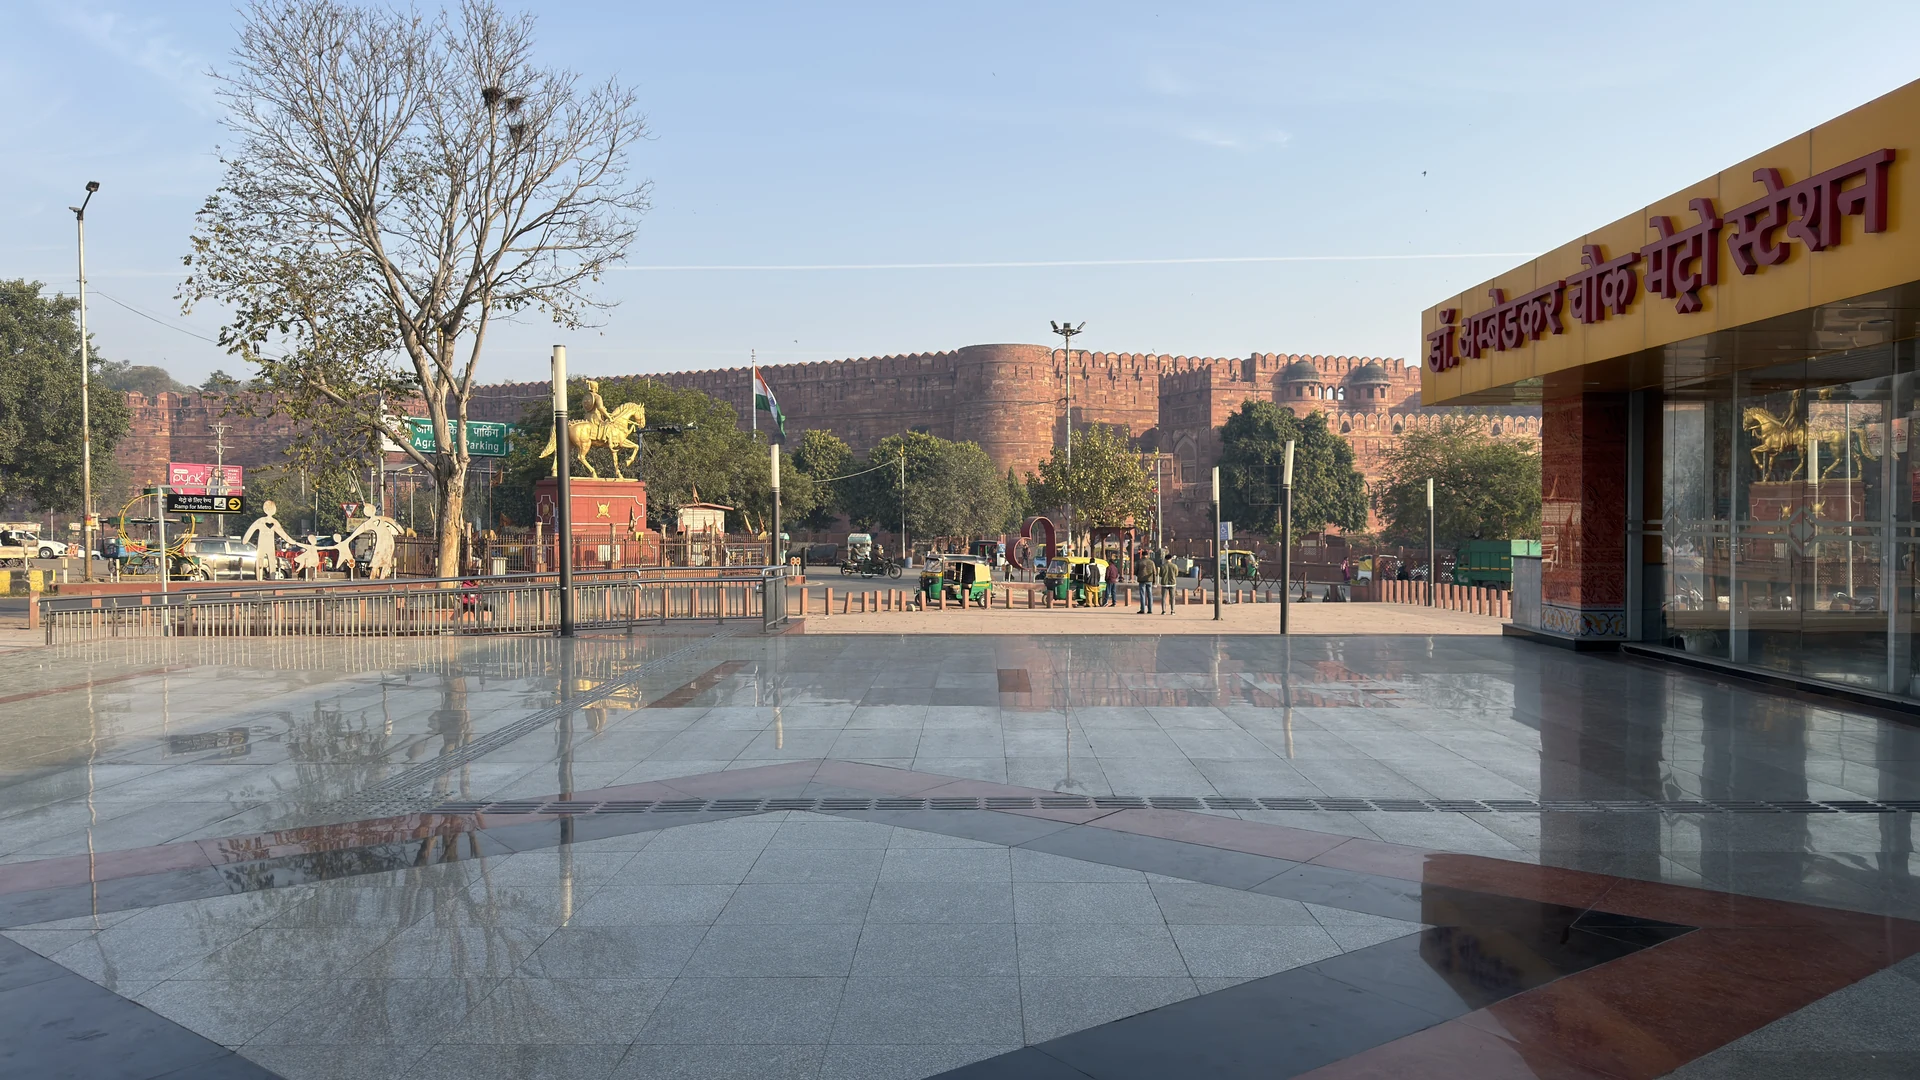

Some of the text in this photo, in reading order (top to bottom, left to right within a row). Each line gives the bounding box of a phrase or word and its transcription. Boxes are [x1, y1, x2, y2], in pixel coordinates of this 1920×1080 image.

[1427, 148, 1896, 374] डॉ. अम्बेडकर चौक मेट्रो स्टेशन
